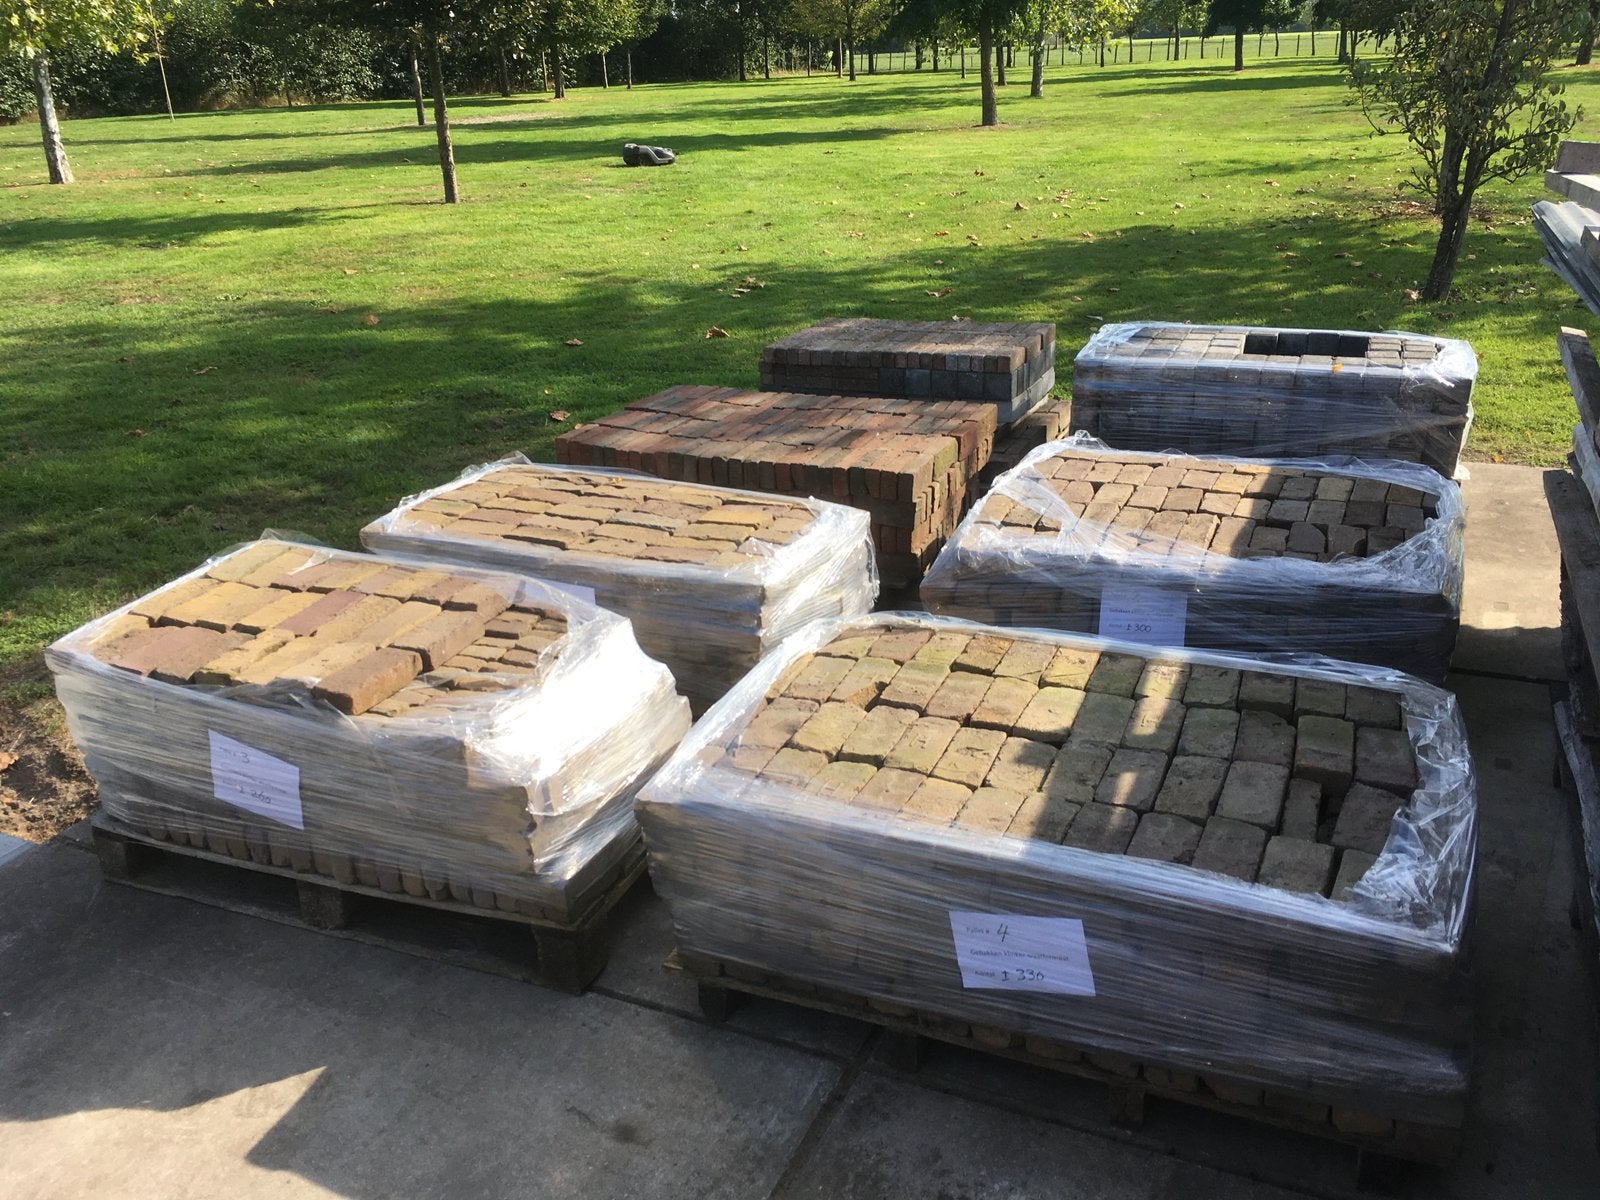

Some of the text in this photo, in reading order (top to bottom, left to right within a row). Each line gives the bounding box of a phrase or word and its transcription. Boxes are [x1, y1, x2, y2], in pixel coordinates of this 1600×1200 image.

[1134, 623, 1152, 632] 300
[240, 752, 250, 764] 3
[996, 923, 1010, 942] 4
[1015, 968, 1045, 981] 330
